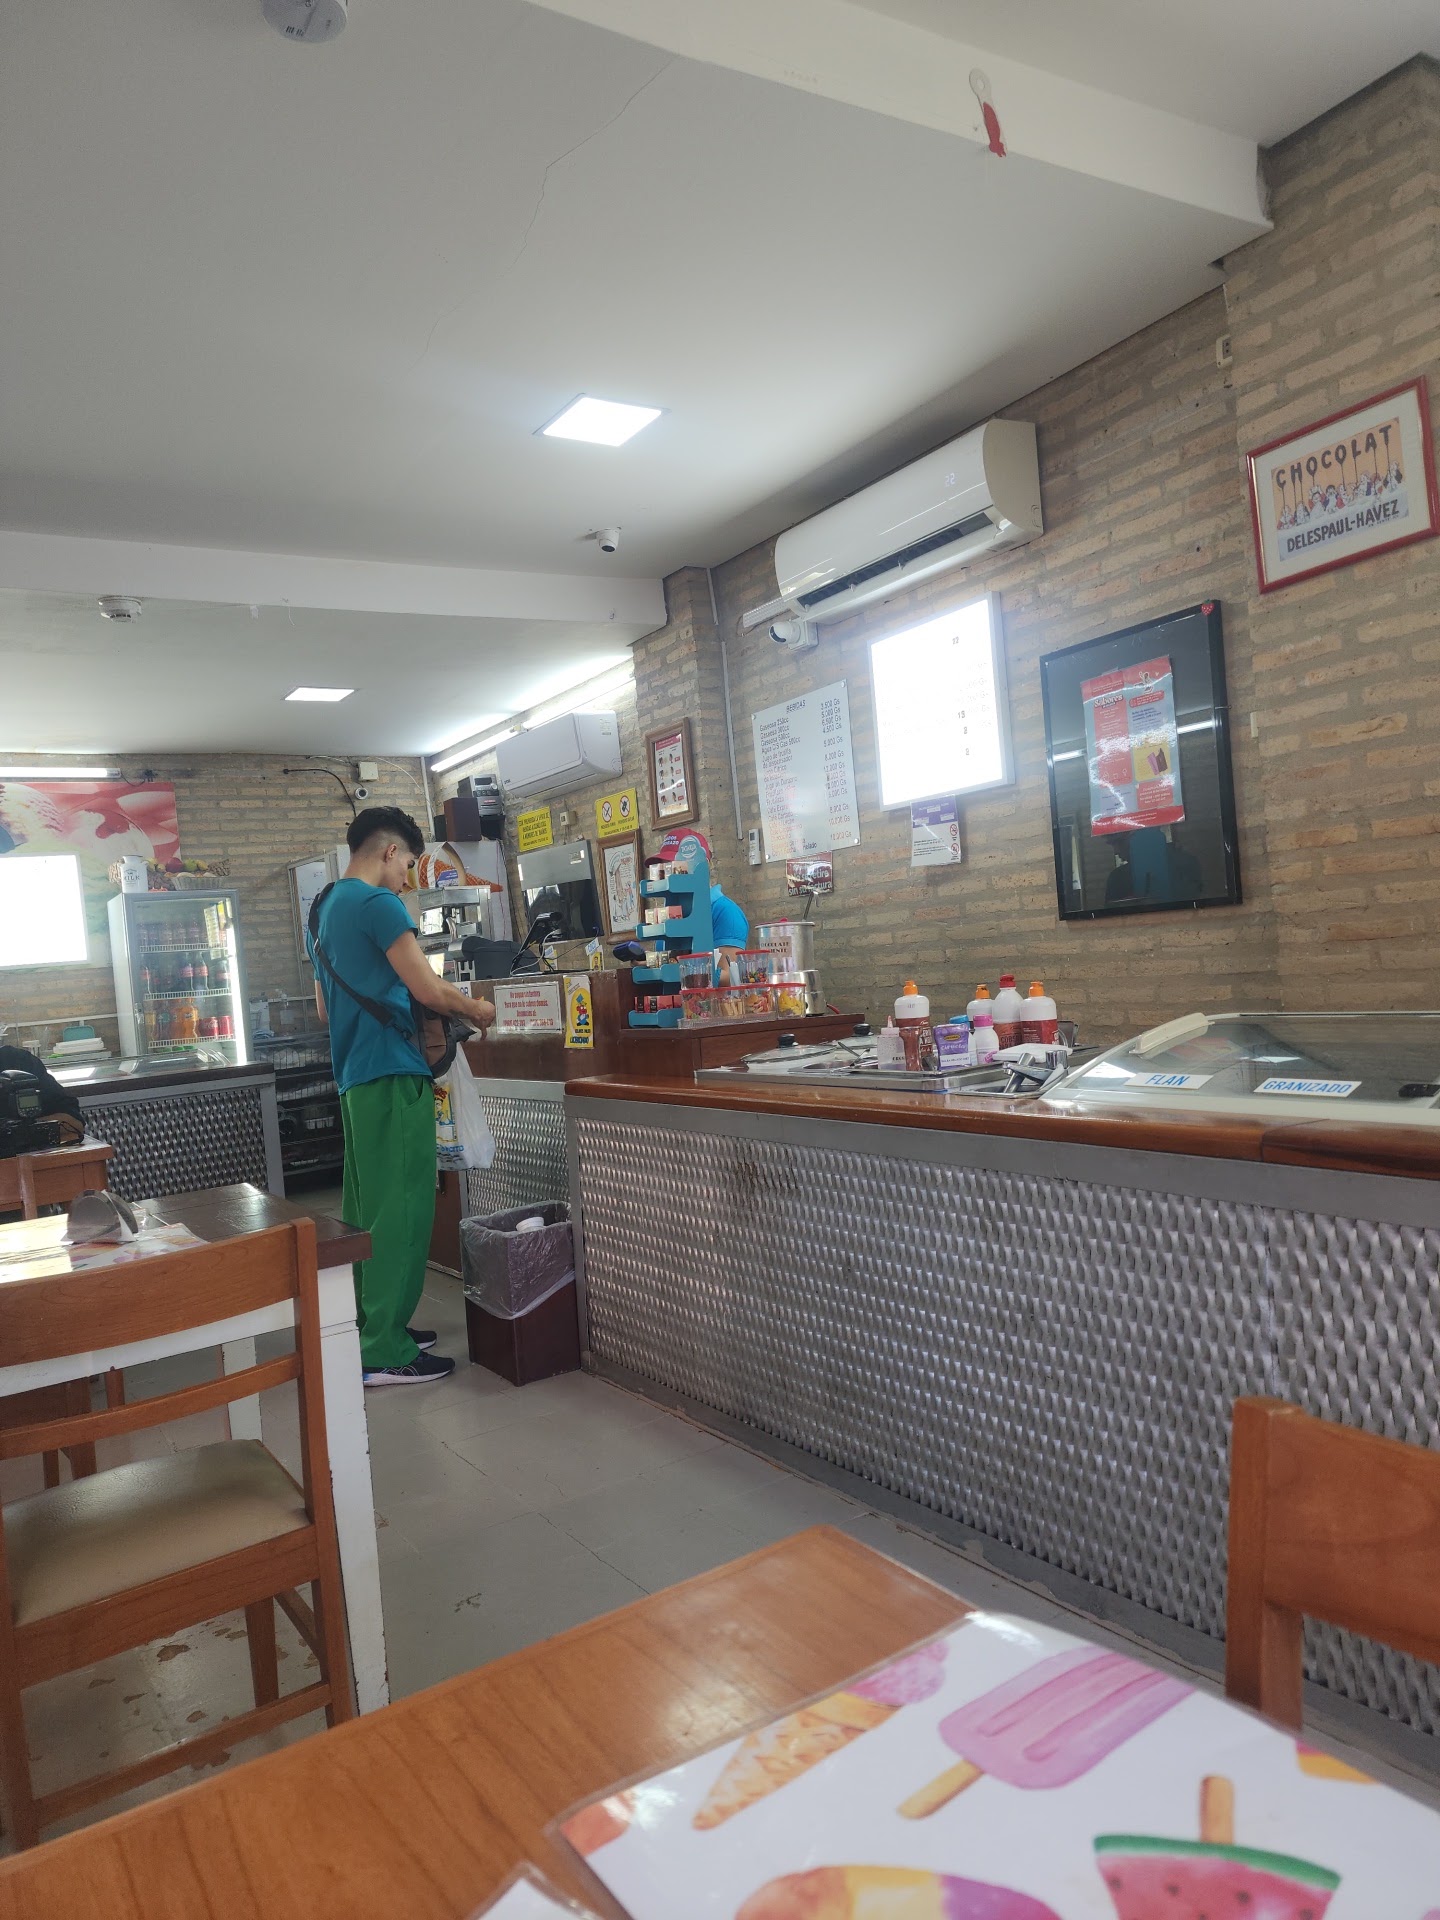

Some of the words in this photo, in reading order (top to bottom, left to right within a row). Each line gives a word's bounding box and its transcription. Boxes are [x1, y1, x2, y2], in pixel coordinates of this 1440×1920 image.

[1276, 425, 1391, 489] CHOCOLAT
[1287, 499, 1399, 553] DELESPAUL-HAVEZ
[1094, 694, 1123, 708] Sabores
[1147, 1074, 1190, 1086] FLAN
[1263, 1081, 1352, 1094] GRANIZADO
